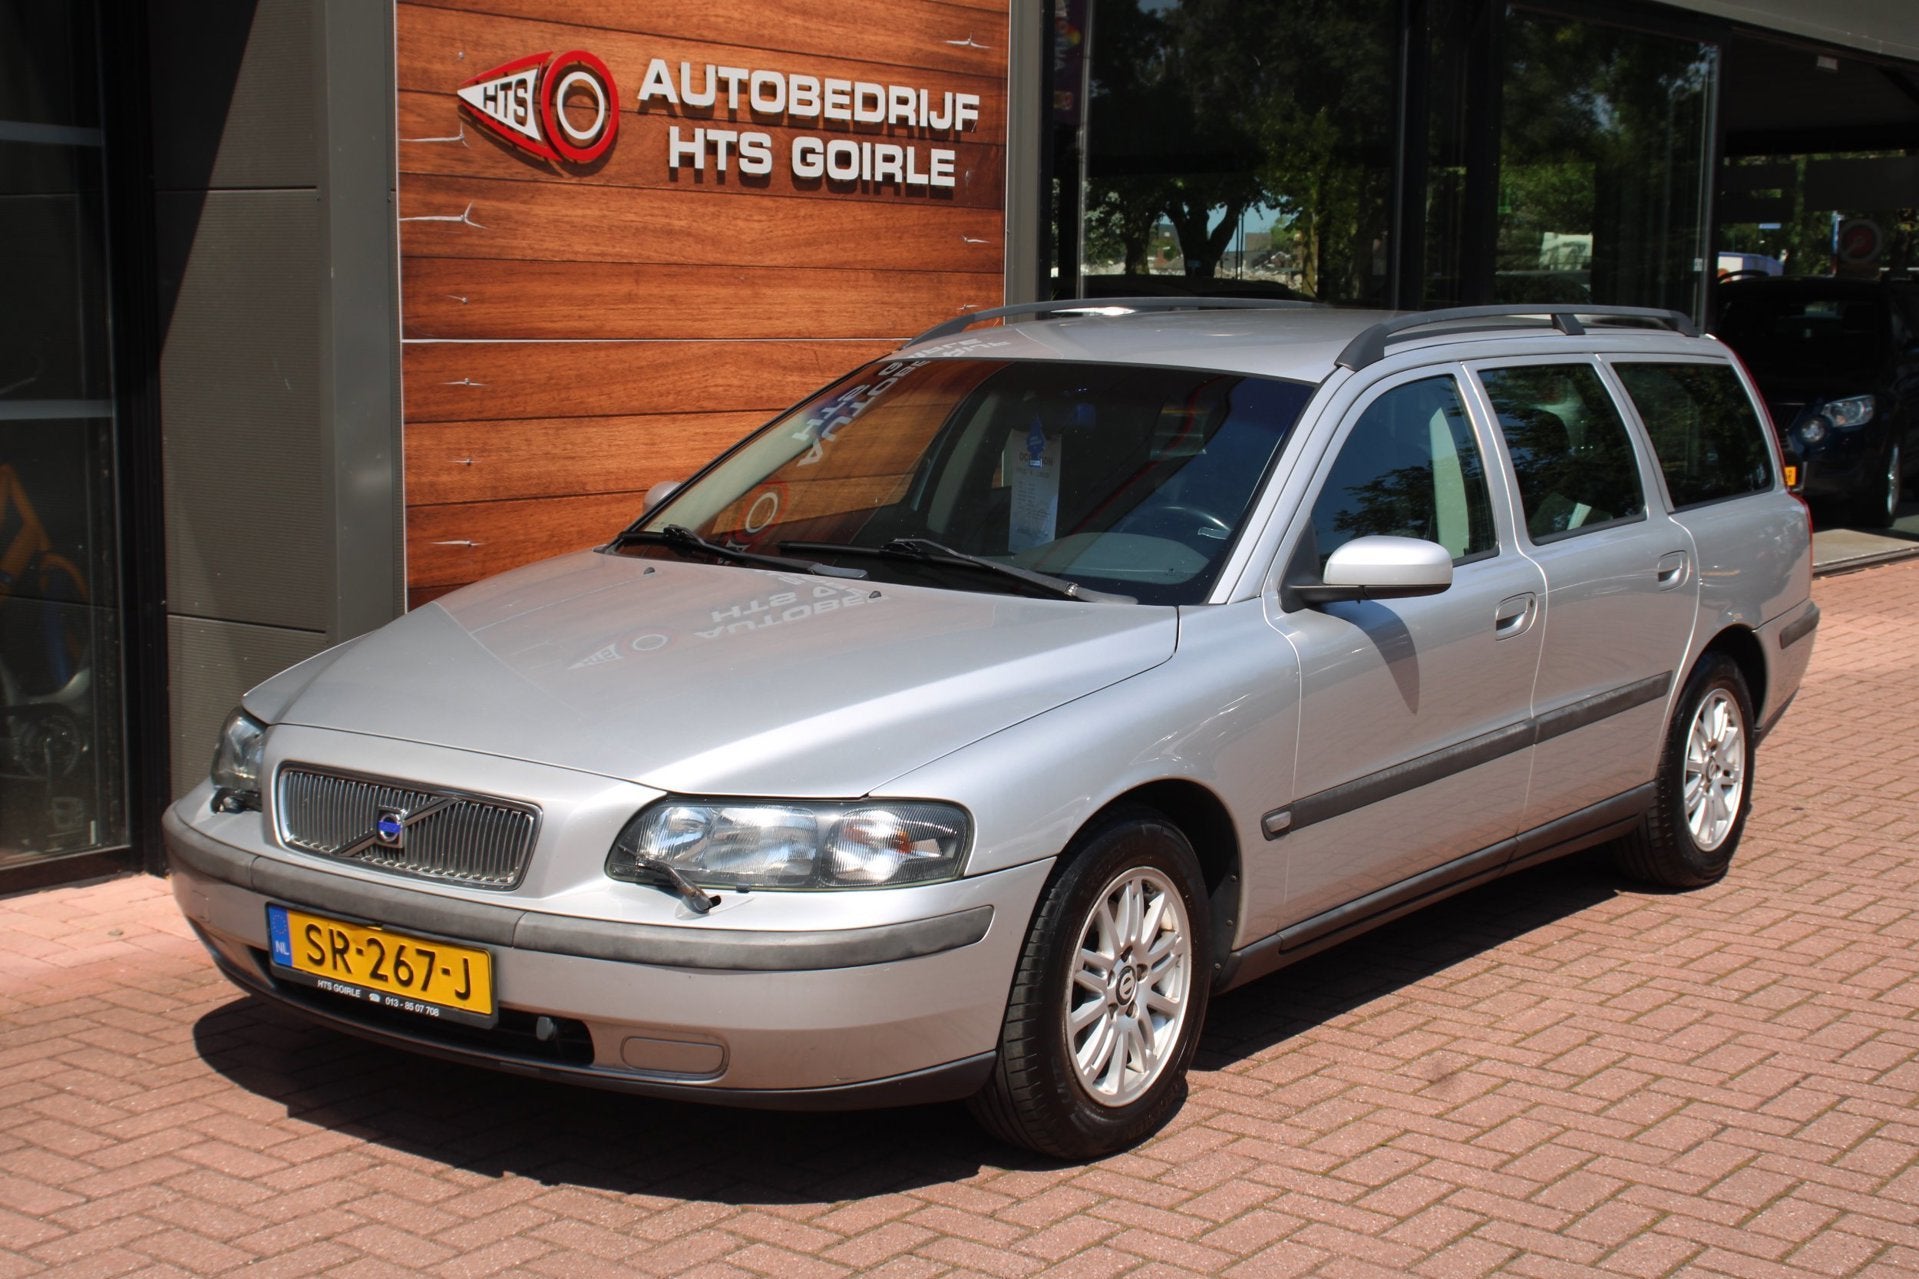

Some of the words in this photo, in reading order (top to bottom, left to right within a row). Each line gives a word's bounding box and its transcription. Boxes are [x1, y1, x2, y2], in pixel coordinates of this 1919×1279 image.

[483, 77, 528, 128] HTS
[637, 58, 980, 132] AUTOBEDRIJF
[669, 126, 773, 175] HTS
[792, 136, 956, 187] GOIRLE
[274, 940, 290, 956] NL
[304, 923, 472, 1001] SR-267-J
[317, 979, 332, 991] HTS
[333, 983, 361, 998] GOIRLE
[385, 996, 399, 1008] 013
[414, 1003, 424, 1013] 07
[425, 1005, 440, 1017] 708
